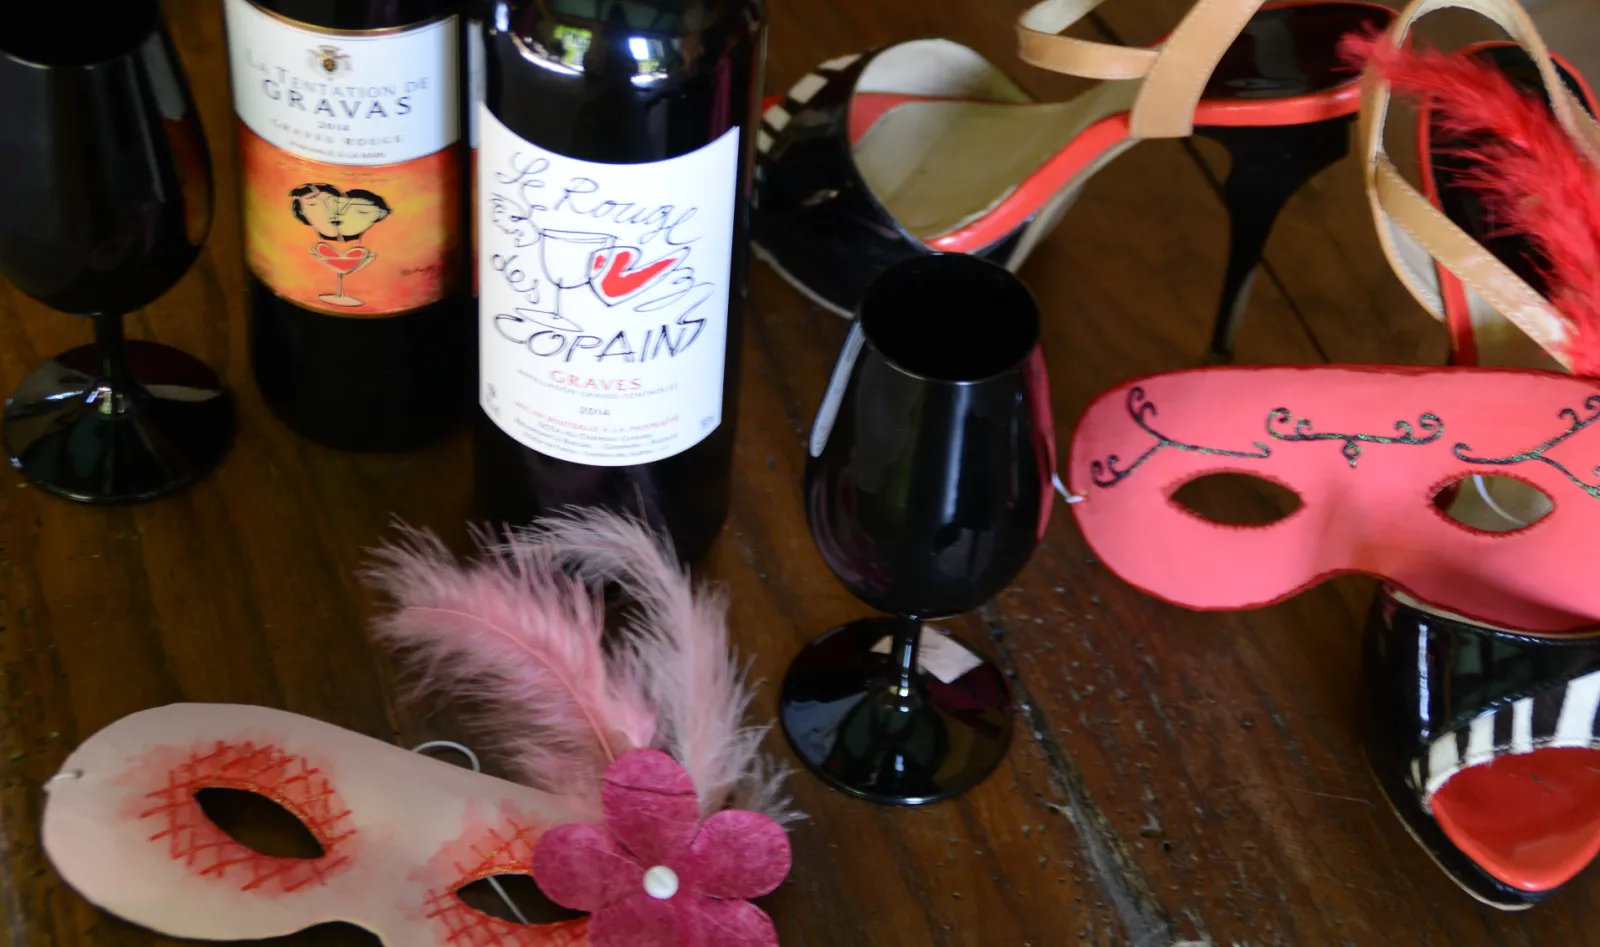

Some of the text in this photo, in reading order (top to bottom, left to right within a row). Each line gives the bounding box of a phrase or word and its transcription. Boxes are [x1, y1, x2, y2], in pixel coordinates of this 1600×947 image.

[261, 78, 413, 119] GRAVAS
[274, 66, 396, 98] TENTATION
[403, 76, 430, 93] DE
[554, 177, 703, 245] Rouge
[550, 369, 642, 392] GRAVES
